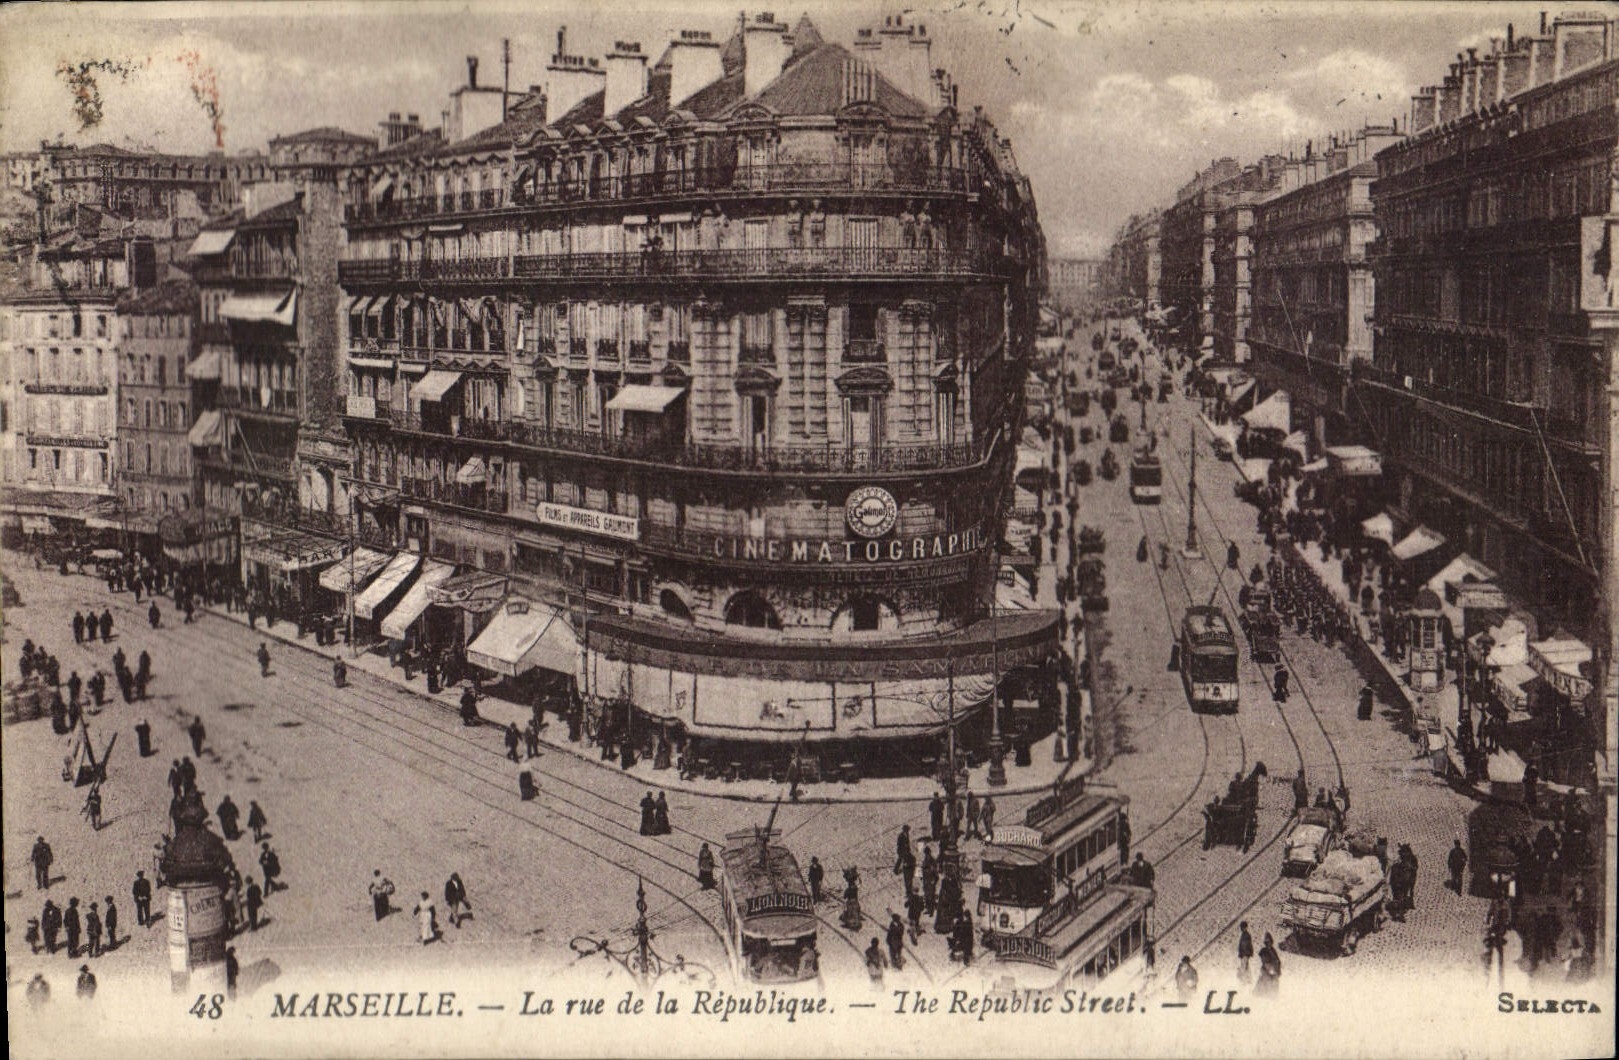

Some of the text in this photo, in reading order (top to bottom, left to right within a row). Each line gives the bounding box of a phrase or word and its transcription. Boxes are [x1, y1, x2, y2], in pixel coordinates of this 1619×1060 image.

[545, 507, 562, 521] FILMS
[570, 511, 600, 529] APPAREILS
[603, 517, 635, 535] GAUMONT
